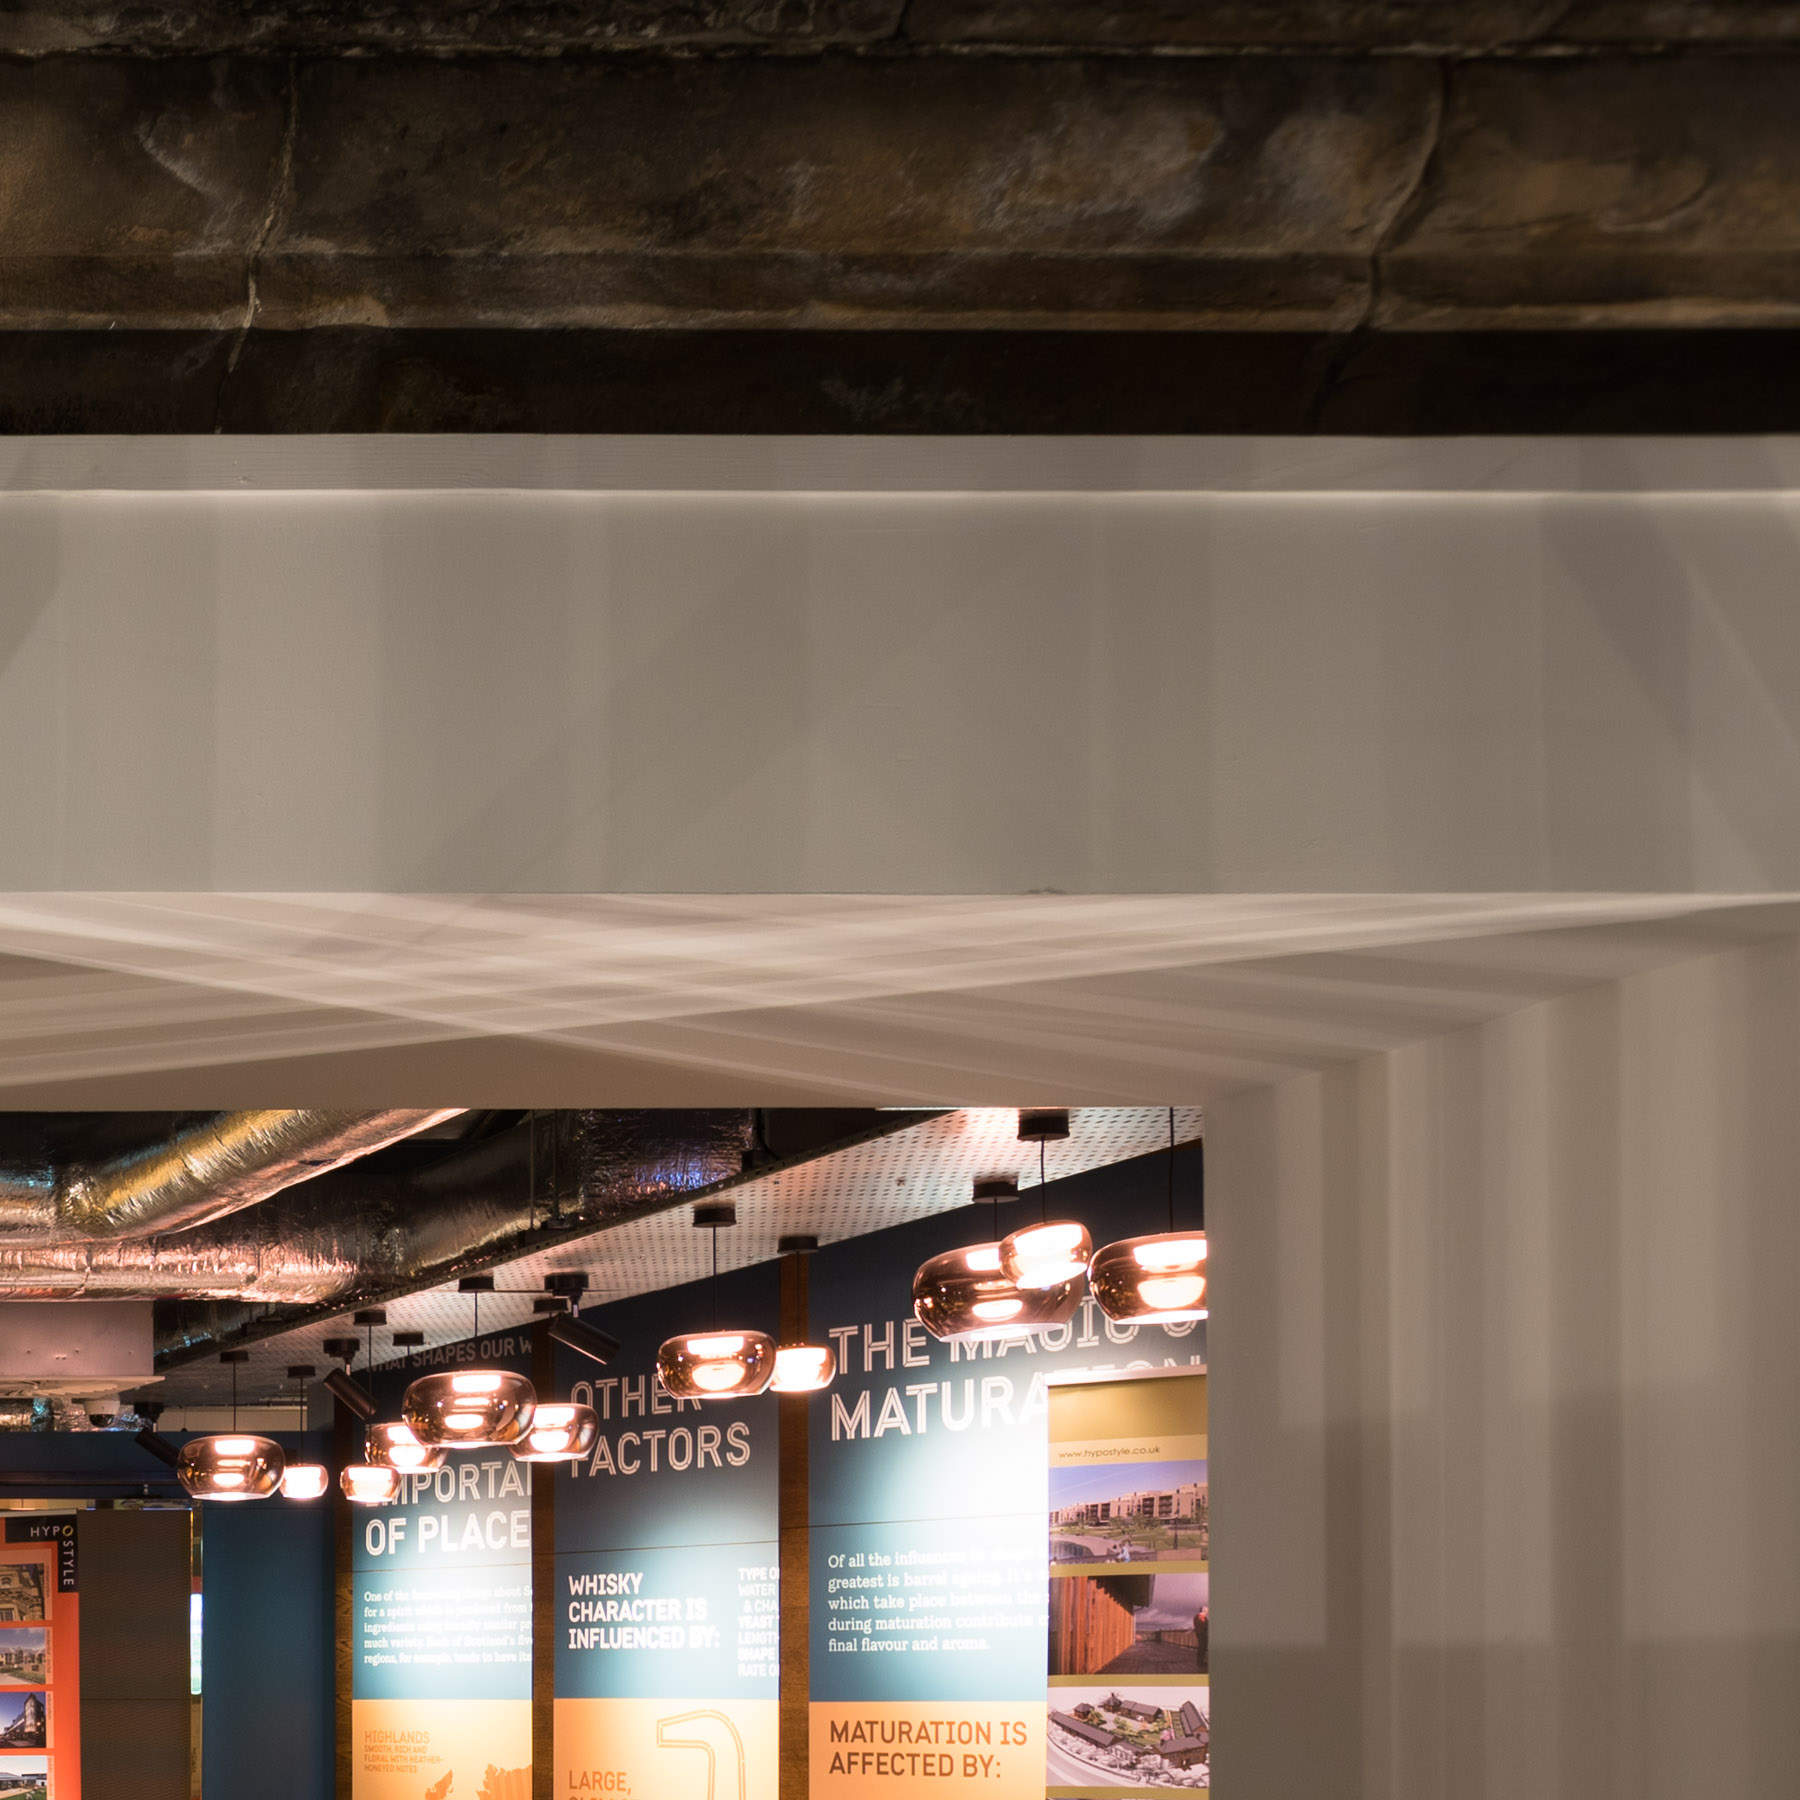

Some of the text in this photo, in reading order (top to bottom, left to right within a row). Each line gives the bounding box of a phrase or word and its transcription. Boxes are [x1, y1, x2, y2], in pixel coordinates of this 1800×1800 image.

[412, 1344, 475, 1368] SHAPES
[481, 1338, 515, 1359] OUR
[829, 1318, 930, 1375] THE
[1059, 1445, 1160, 1458] www.hypostyle.co.uk
[366, 1461, 531, 1507] MPORTA
[31, 1525, 74, 1537] HYPO
[366, 1510, 529, 1556] OF PLACE
[63, 1540, 74, 1585] STYLE
[828, 1555, 845, 1568] Of
[848, 1553, 865, 1567] all
[868, 1553, 891, 1566] the
[738, 1567, 779, 1581] TYPE O
[828, 1574, 883, 1592] greatest
[888, 1573, 899, 1587] is
[904, 1570, 947, 1586] barrel
[568, 1573, 643, 1595] WHISKY
[737, 1584, 776, 1597] WATER
[364, 1592, 382, 1601] One
[384, 1591, 393, 1601] of
[828, 1597, 869, 1610] which
[873, 1595, 904, 1609] take
[909, 1593, 946, 1611] place
[364, 1607, 377, 1617] for
[379, 1609, 384, 1617] a
[568, 1597, 708, 1622] CHARACTER IS
[737, 1616, 774, 1628] YEAST
[828, 1617, 872, 1634] during
[875, 1615, 952, 1630] maturation
[364, 1638, 388, 1648] much
[568, 1625, 720, 1649] INFLUENCED BY:
[828, 1637, 991, 1652] final flavour and aroma.
[364, 1653, 398, 1666] regions,
[737, 1647, 776, 1661] SHAPE
[738, 1664, 779, 1677] RATE O
[364, 1730, 430, 1745] HIGHLANDS
[830, 1720, 1027, 1745] MATURATION IS
[364, 1745, 394, 1753] SMOOTH,
[365, 1754, 388, 1762] FLORAL
[390, 1755, 408, 1763] WITH
[829, 1752, 1000, 1778] AFFECTED BY:
[396, 1765, 417, 1773] NOTES
[569, 1770, 631, 1795] LARGE,
